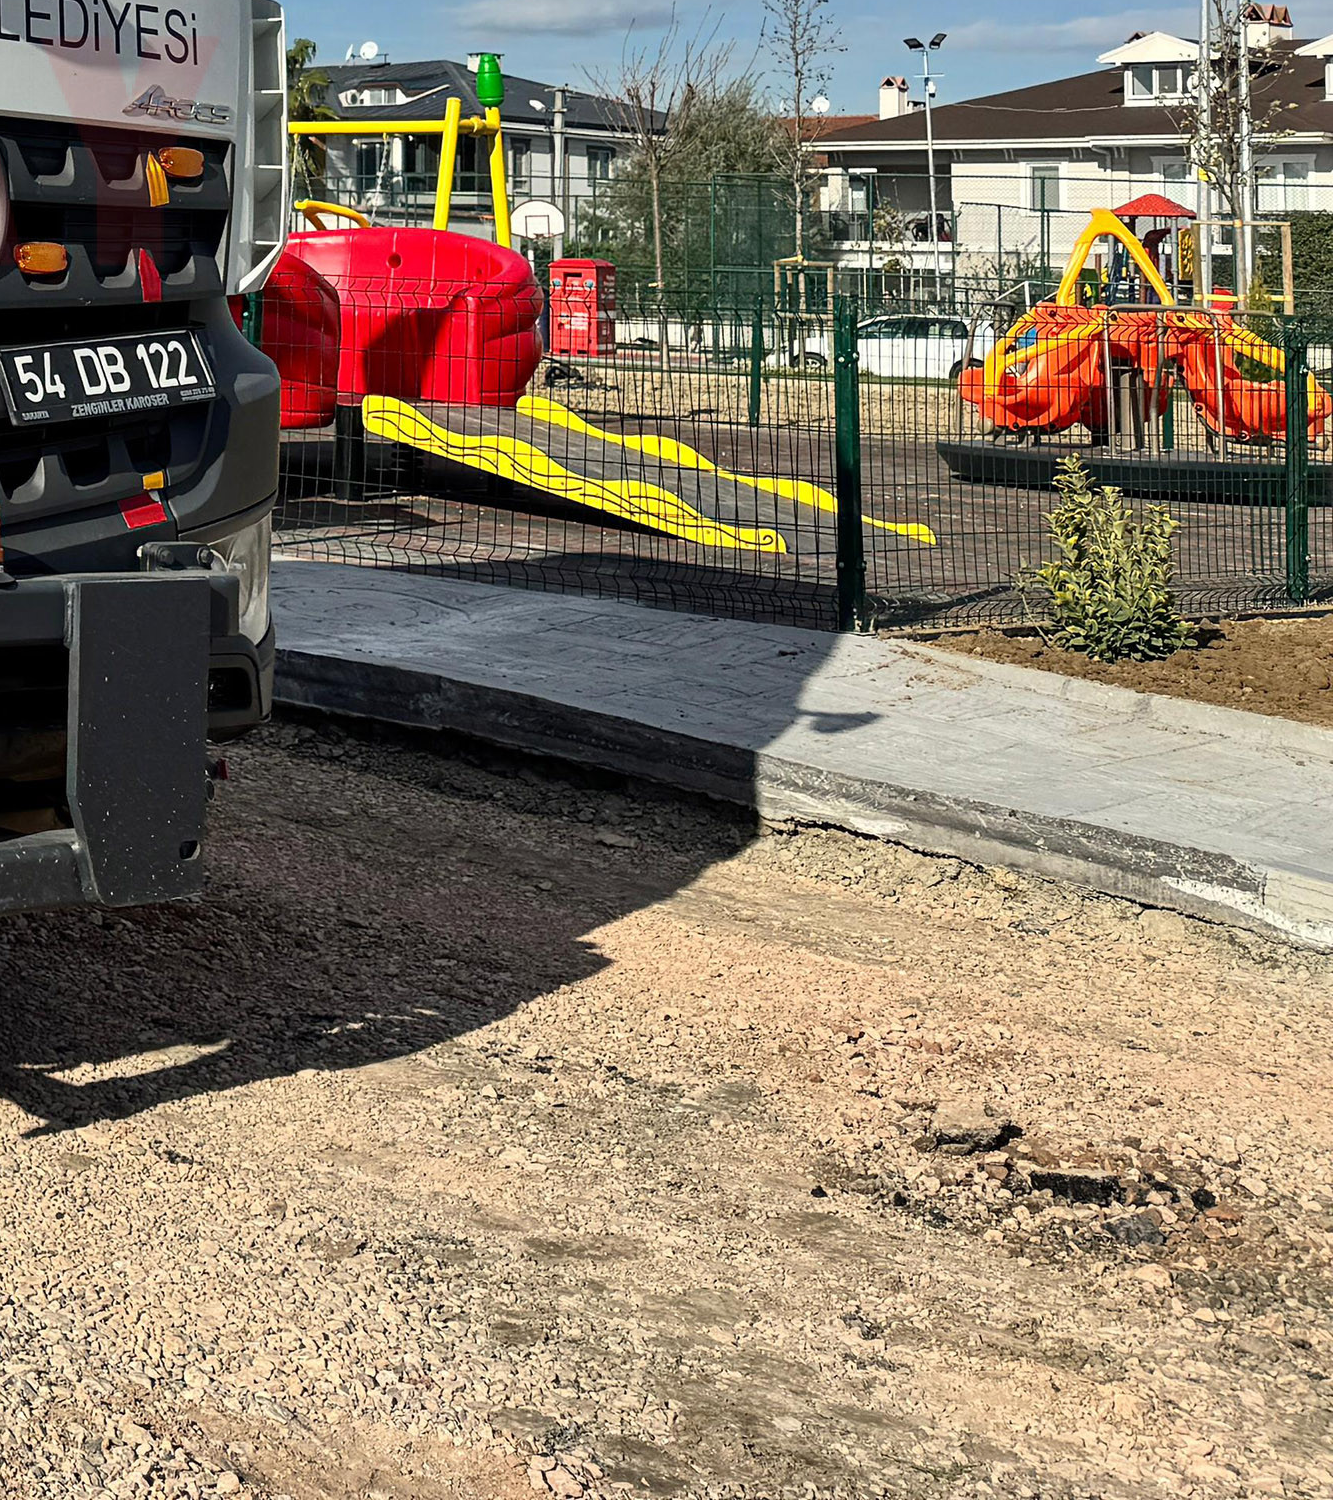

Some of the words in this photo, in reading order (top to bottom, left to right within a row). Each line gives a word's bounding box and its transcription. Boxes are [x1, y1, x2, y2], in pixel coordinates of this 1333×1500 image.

[14, 352, 66, 403] 54
[73, 346, 131, 396] DB
[136, 340, 198, 389] 122
[125, 393, 170, 410] KAROSER
